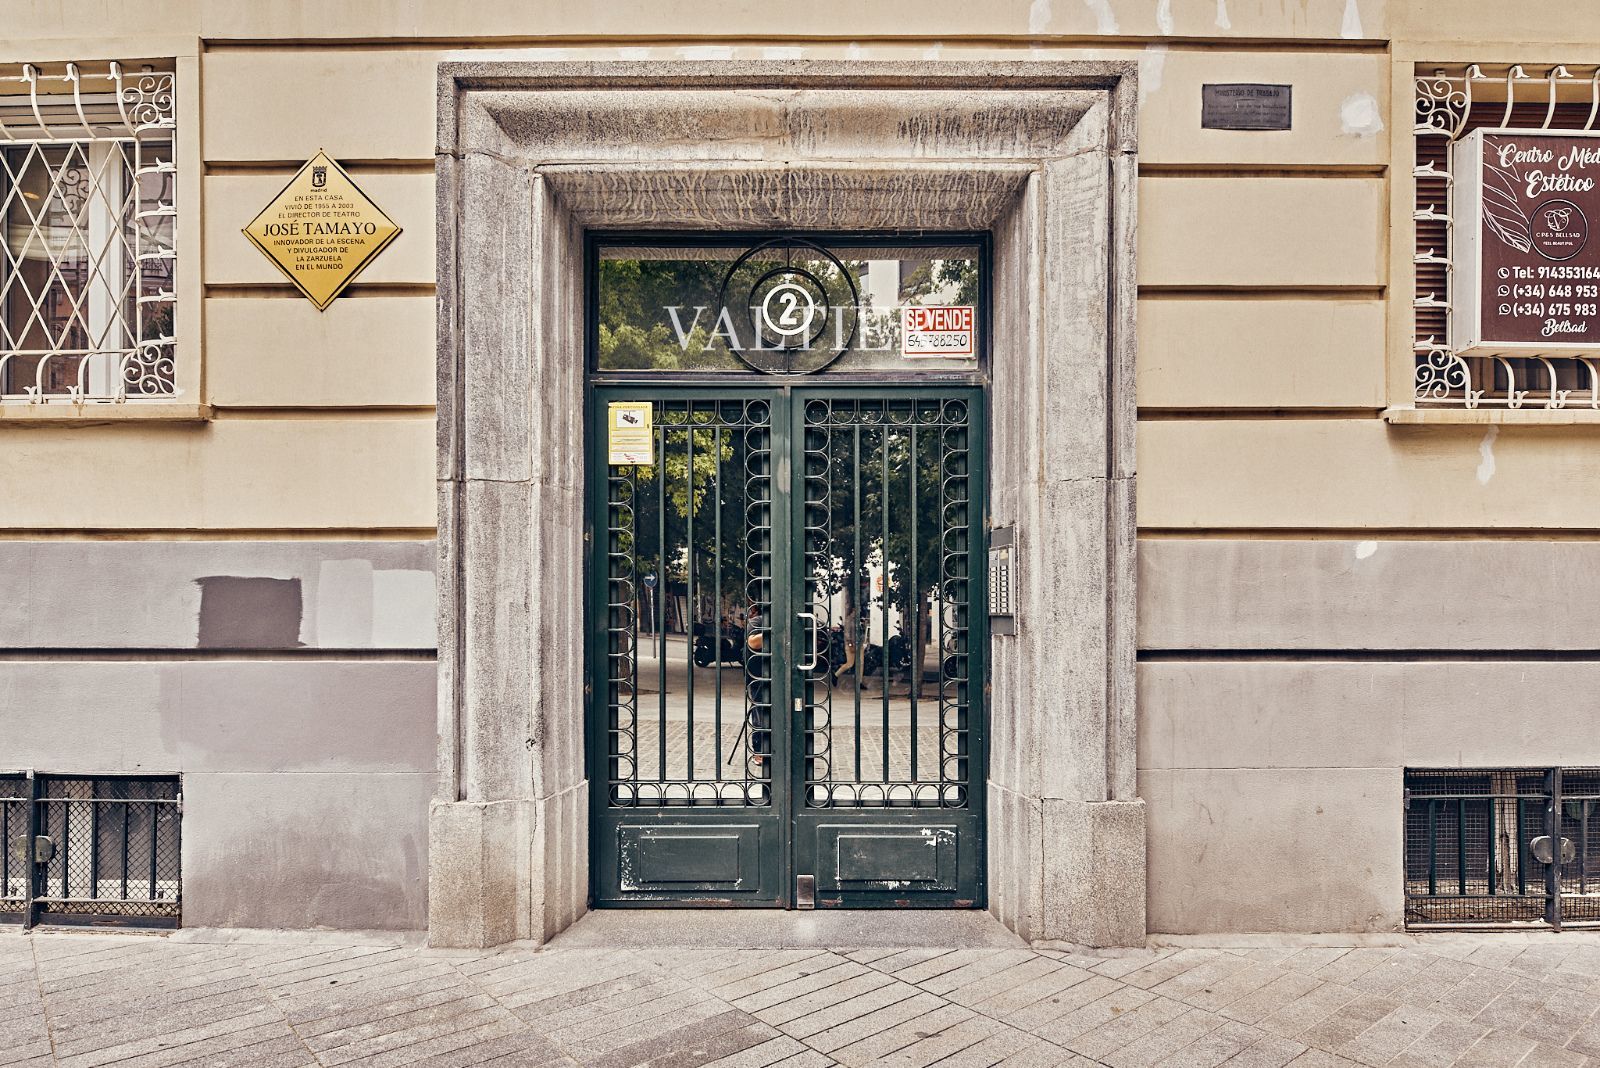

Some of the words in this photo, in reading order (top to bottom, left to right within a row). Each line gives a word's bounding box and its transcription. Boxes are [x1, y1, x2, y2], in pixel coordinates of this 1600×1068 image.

[1498, 143, 1554, 168] Centro
[1524, 169, 1595, 198] Estético
[263, 219, 299, 237] JOSÉ
[303, 222, 377, 235] TAMAYO
[273, 238, 314, 246] INNOVADOR
[1512, 266, 1535, 279] Tel:
[1537, 266, 1600, 279] 914353164
[1513, 283, 1545, 299] (+34)
[1548, 285, 1572, 297] 648
[1575, 285, 1598, 298] 953
[779, 292, 798, 325] 2
[1513, 302, 1545, 318] (+34)
[1548, 303, 1571, 316] 675
[1574, 303, 1597, 316] 983
[906, 309, 924, 331] SE
[926, 309, 971, 331] VENDE
[1541, 318, 1588, 337] Bellsad
